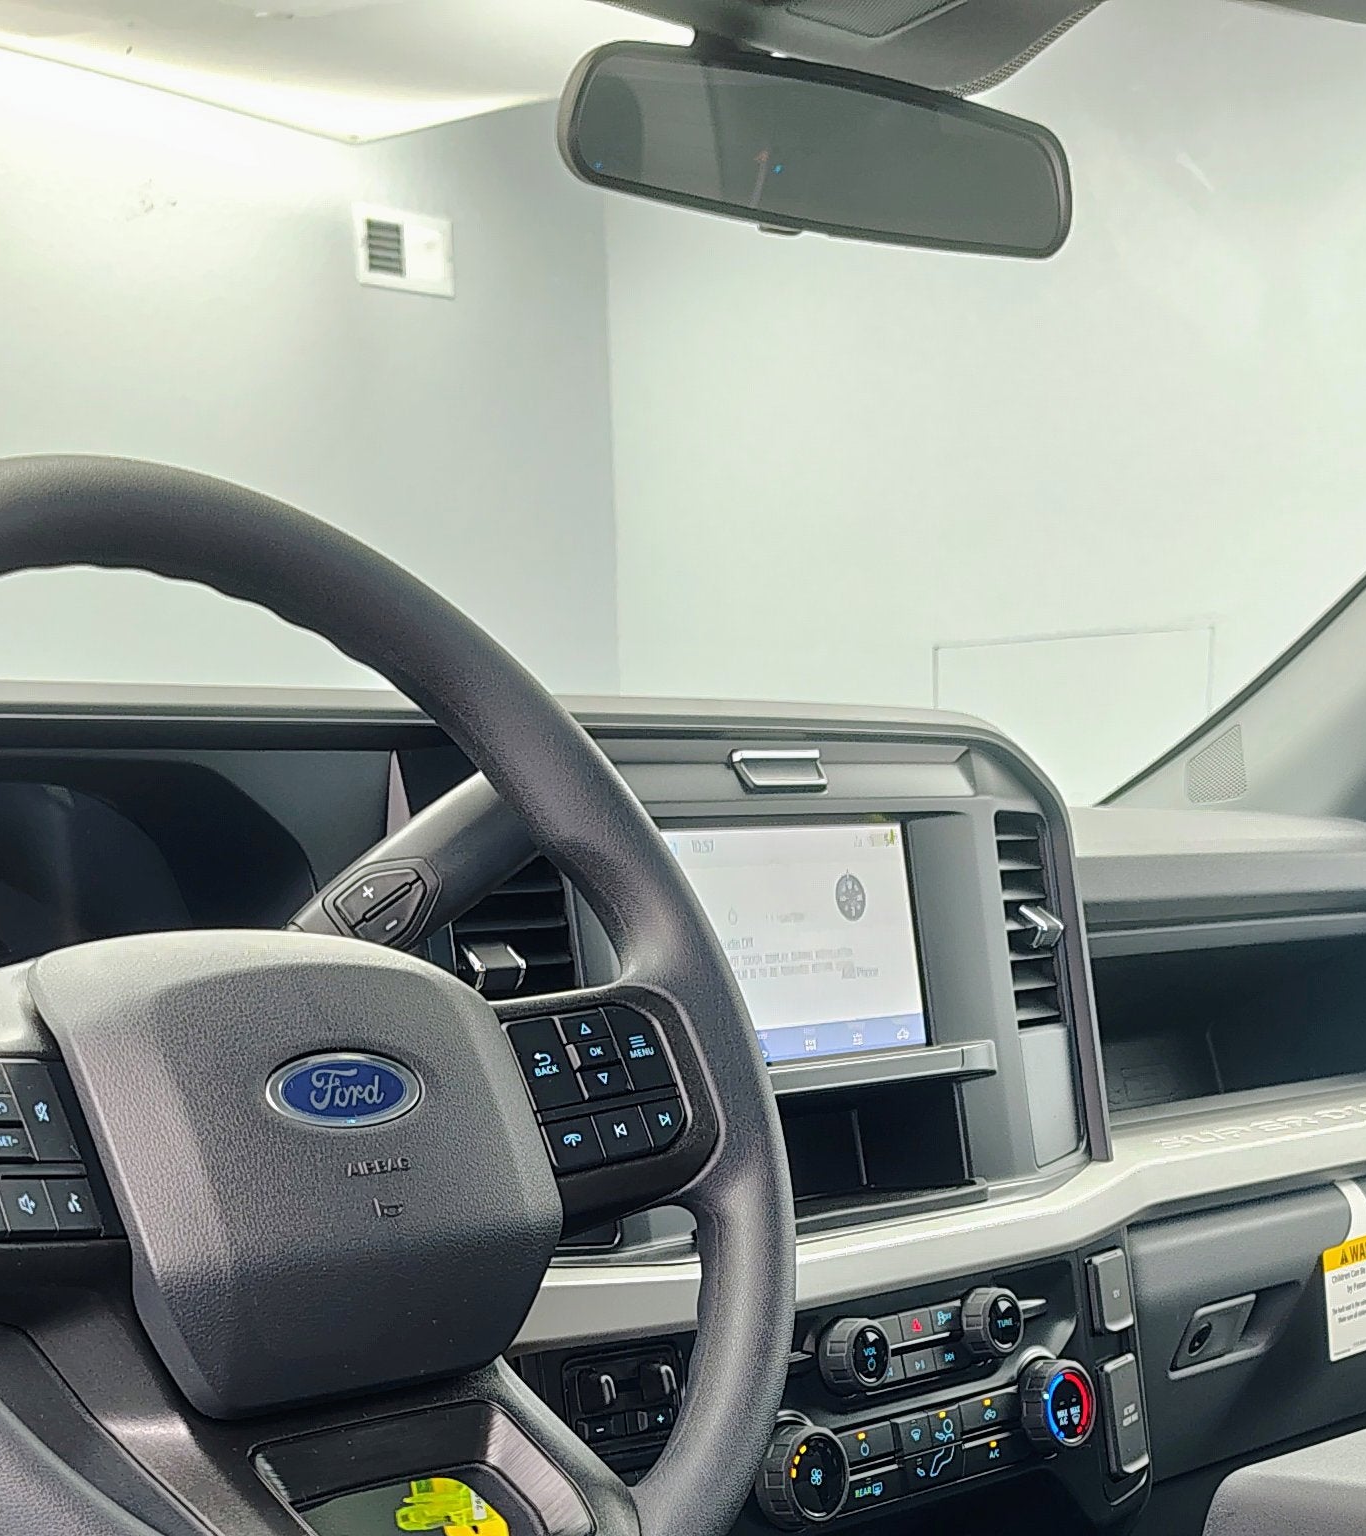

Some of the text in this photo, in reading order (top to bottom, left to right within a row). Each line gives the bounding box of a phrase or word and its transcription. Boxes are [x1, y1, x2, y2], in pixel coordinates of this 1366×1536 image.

[589, 1046, 604, 1057] OK
[629, 1047, 655, 1059] MENU
[535, 1064, 559, 1077] BACK
[310, 1068, 384, 1111] Ford
[346, 1157, 412, 1178] AIRBAG
[997, 1317, 1014, 1329] TUNE
[863, 1346, 877, 1357] VOL
[989, 1447, 1001, 1458] A/C
[855, 1486, 873, 1498] REAR
